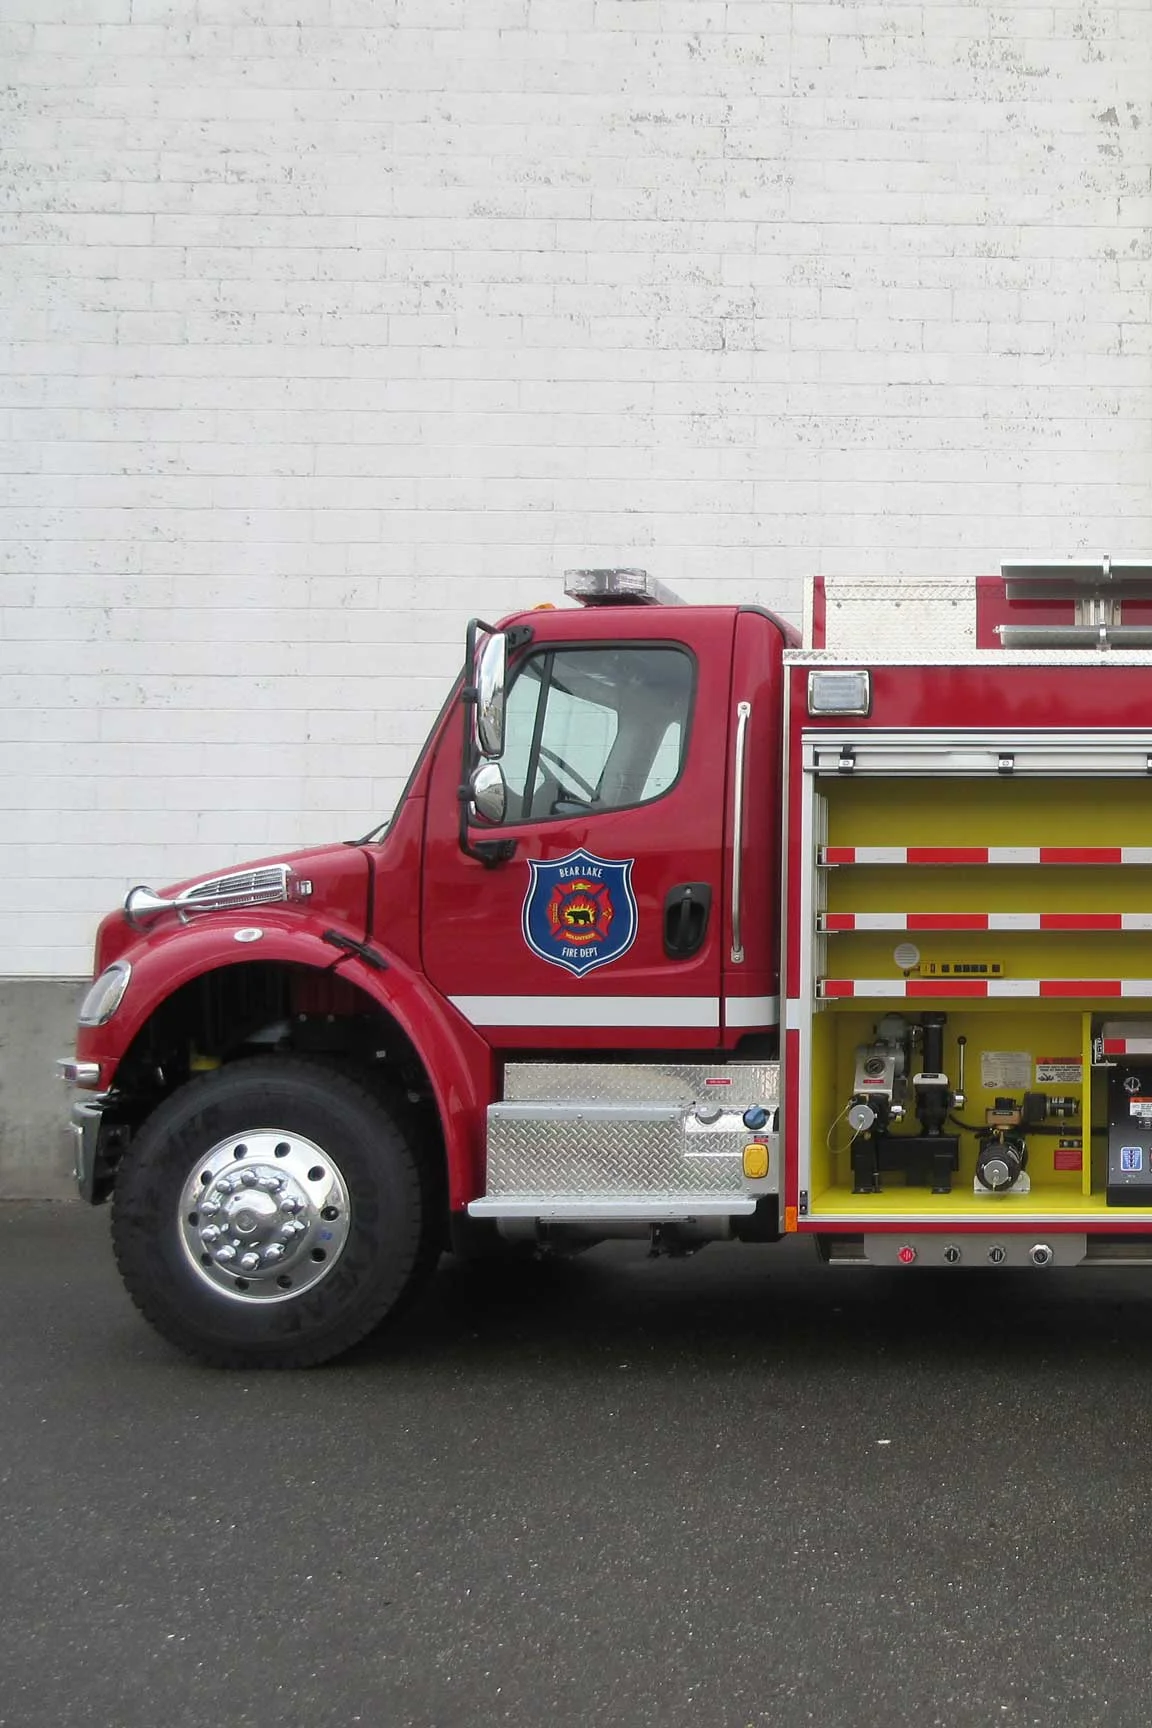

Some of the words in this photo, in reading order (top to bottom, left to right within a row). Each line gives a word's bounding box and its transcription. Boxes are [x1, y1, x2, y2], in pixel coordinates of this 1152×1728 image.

[559, 866, 580, 878] BEAR
[581, 866, 603, 878] LAKE
[561, 947, 578, 958] FIRE
[579, 947, 598, 958] DEPT
